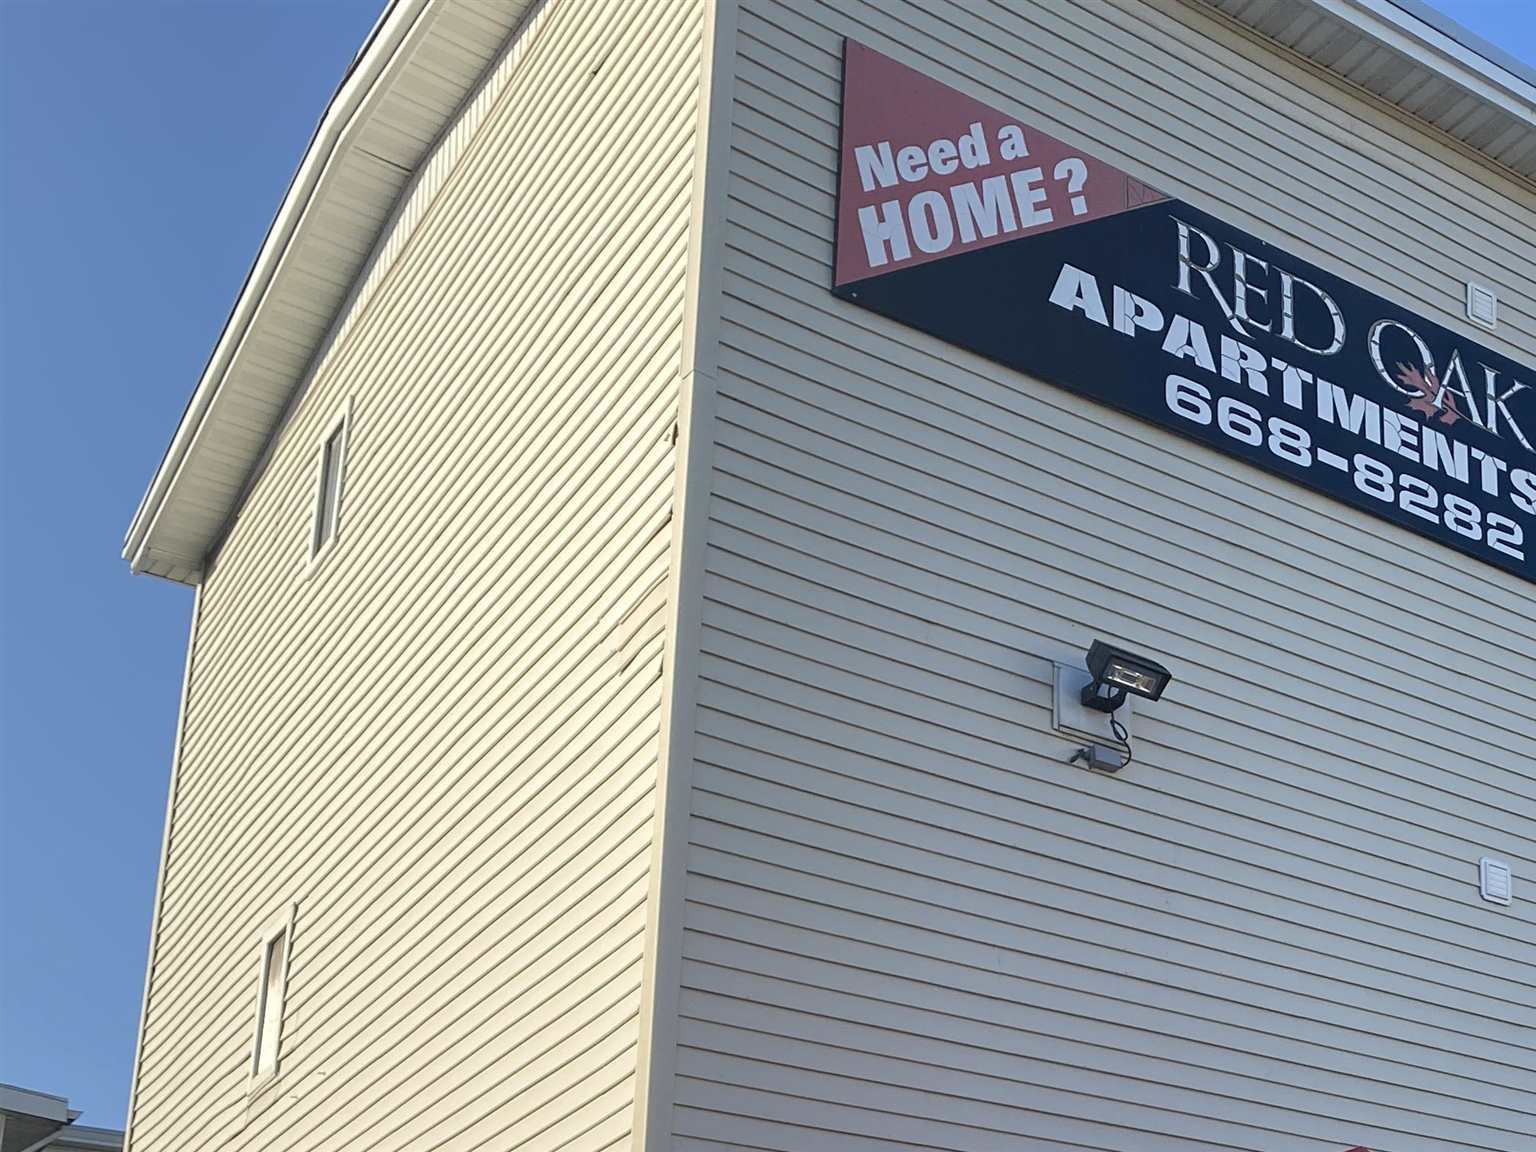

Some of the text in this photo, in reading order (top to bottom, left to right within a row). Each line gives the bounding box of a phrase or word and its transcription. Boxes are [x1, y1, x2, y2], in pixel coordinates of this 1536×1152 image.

[854, 122, 1030, 192] Need a
[857, 157, 1089, 268] HOME?
[1168, 214, 1347, 356] RED
[1165, 374, 1526, 562] 668-8282
